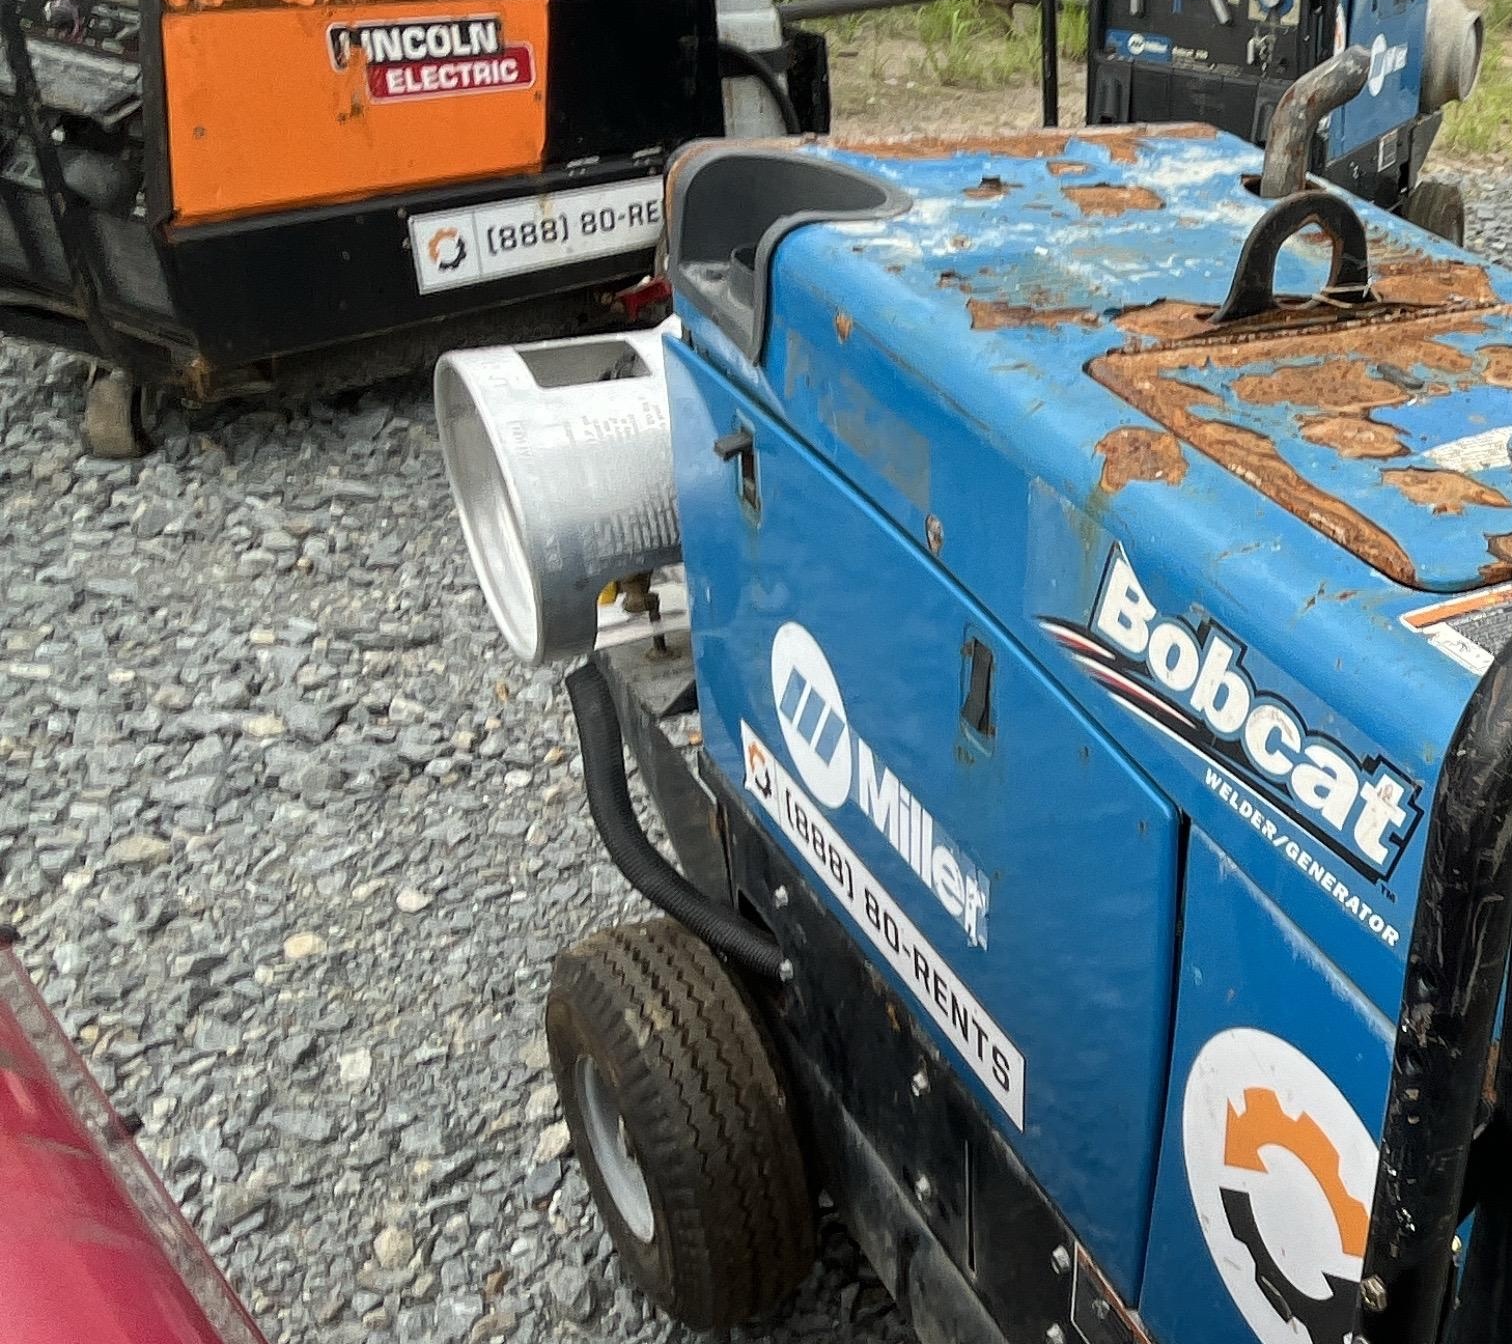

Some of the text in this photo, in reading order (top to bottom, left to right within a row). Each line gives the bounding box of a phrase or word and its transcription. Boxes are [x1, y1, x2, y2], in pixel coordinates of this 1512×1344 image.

[385, 58, 519, 95] ELECTRIC
[486, 199, 662, 256] (888) 80-RE
[1097, 557, 1407, 865] Bobcat
[783, 786, 1011, 1093] (888) 80-RENTS
[858, 738, 988, 952] Miller
[1205, 767, 1400, 946] WELDER/GENERATOR
